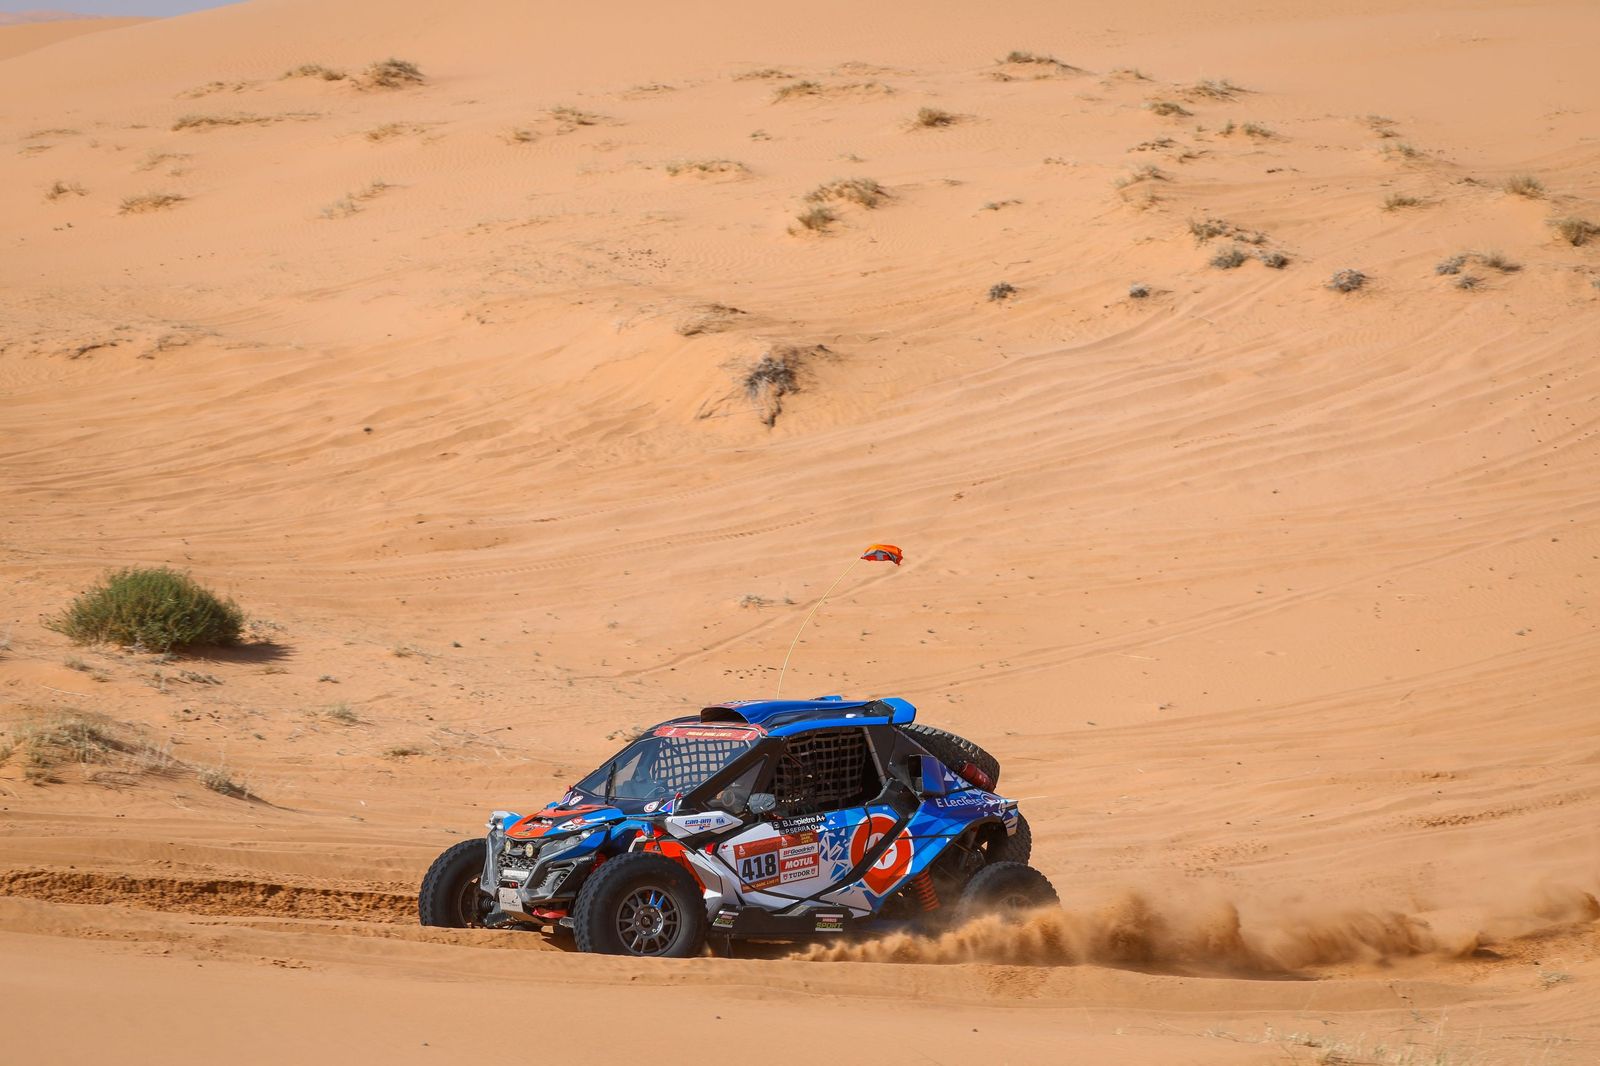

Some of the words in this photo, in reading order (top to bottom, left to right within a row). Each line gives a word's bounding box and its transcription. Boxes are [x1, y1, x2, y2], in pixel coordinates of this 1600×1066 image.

[783, 846, 815, 856] BFGoodrich
[742, 854, 777, 881] 418
[784, 857, 814, 869] MOTUL
[789, 870, 810, 879] TUDOR
